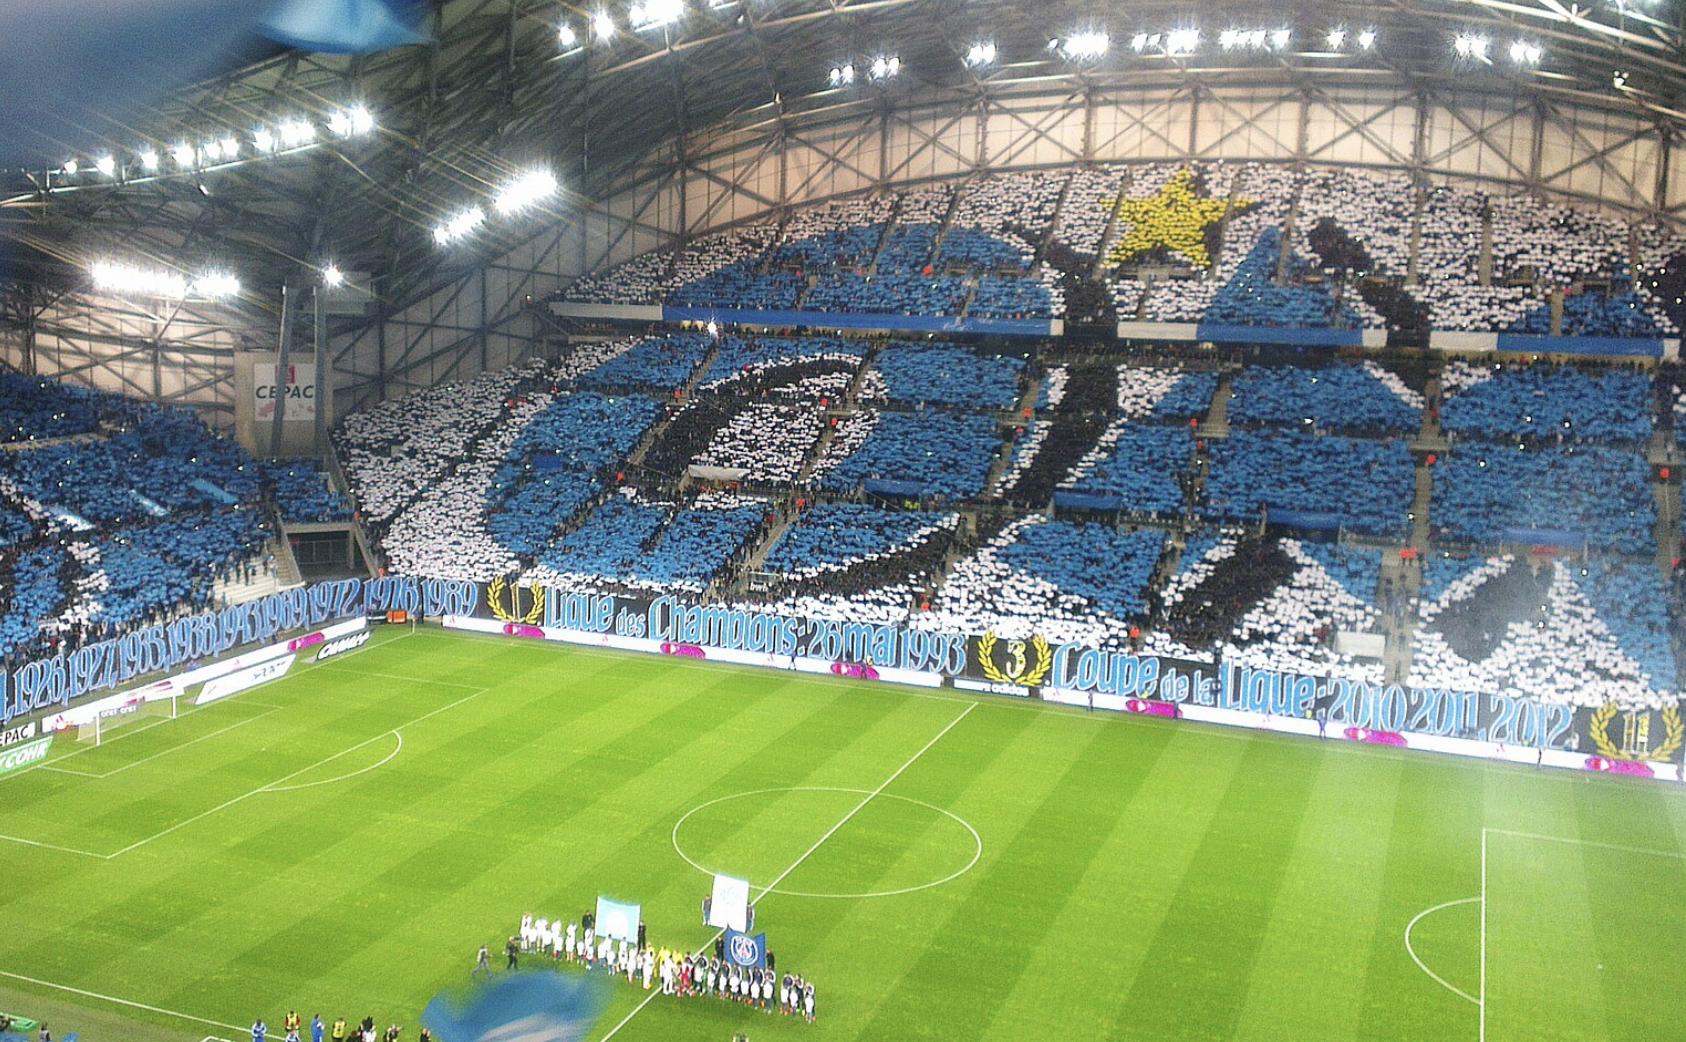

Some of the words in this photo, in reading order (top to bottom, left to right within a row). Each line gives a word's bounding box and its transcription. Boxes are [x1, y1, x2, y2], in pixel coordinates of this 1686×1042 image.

[421, 576, 478, 617] 1989
[615, 606, 646, 638] des
[806, 618, 842, 661] 26
[843, 621, 898, 667] mai
[900, 628, 967, 676] 1993
[1006, 640, 1027, 679] 3
[1052, 640, 1160, 698] Coupe
[1160, 667, 1189, 702] de
[1193, 669, 1218, 705] la
